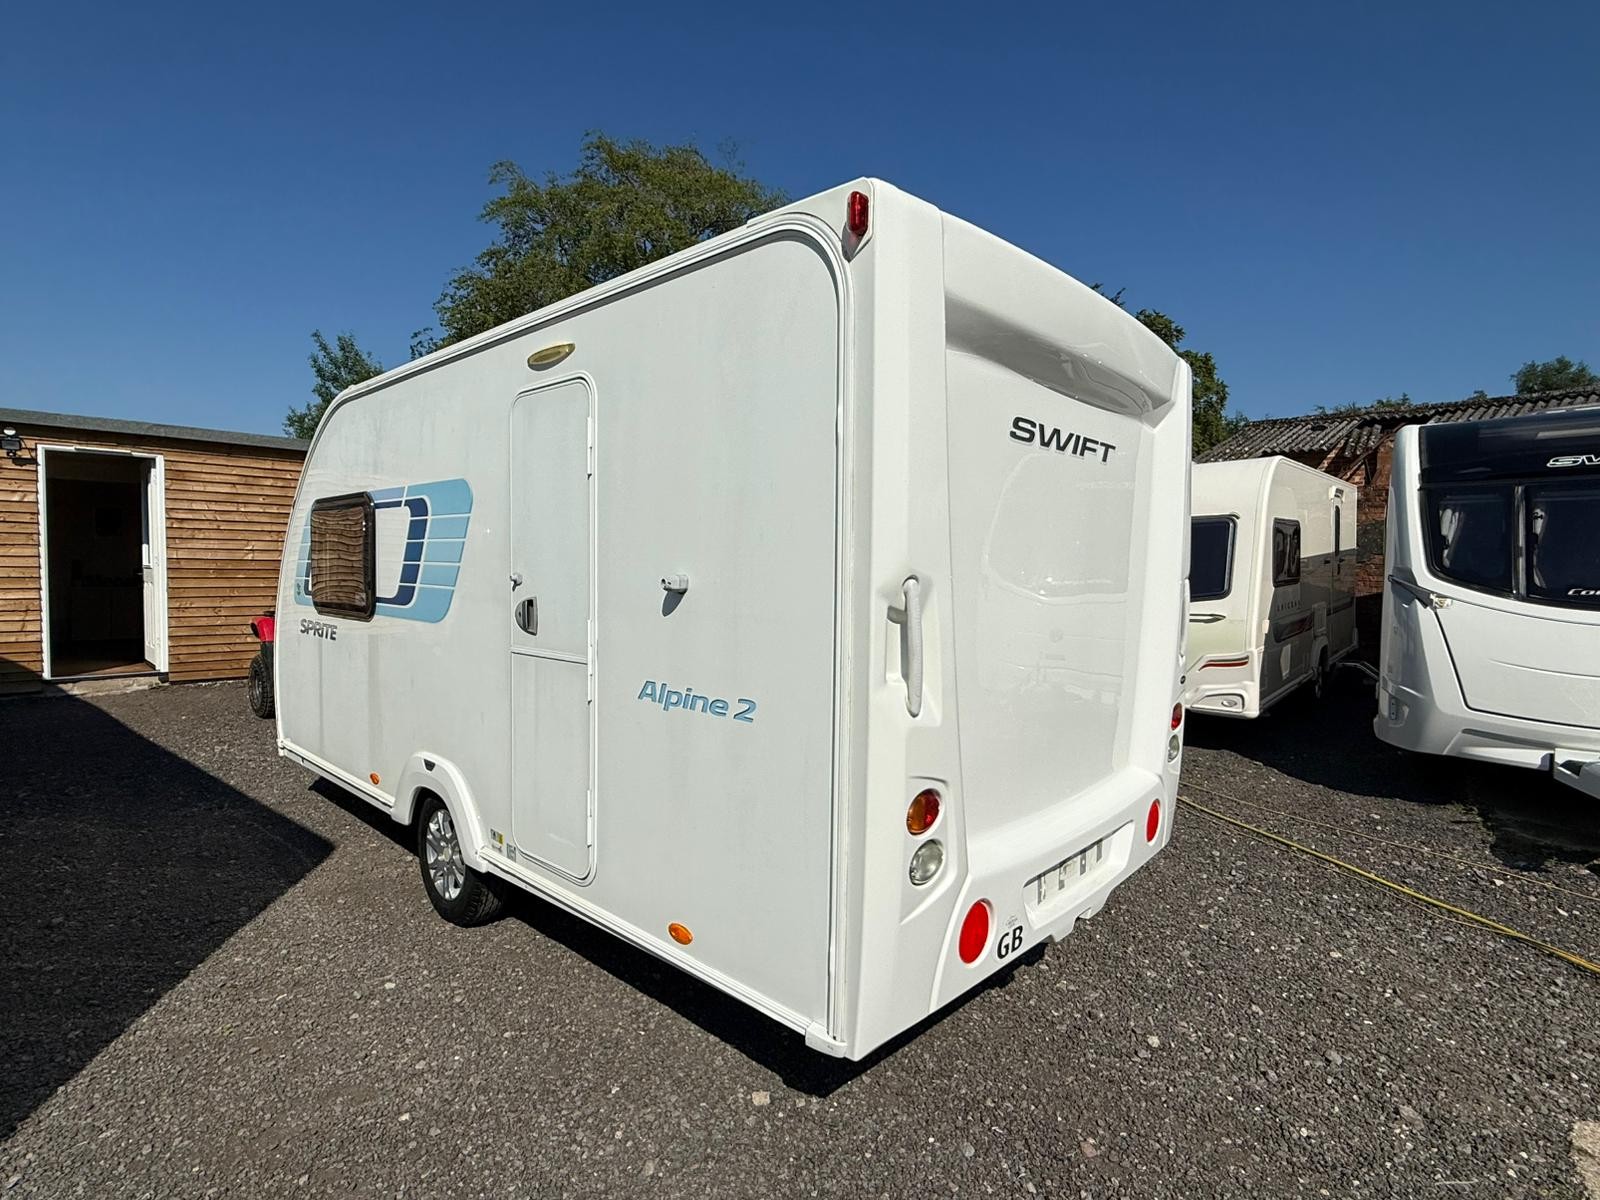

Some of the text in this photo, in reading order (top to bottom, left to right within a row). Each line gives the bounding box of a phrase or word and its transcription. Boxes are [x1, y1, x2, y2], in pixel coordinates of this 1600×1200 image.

[1009, 416, 1116, 463] SWIFT
[300, 618, 338, 641] SPRITE
[638, 680, 757, 723] Alpine 2
[997, 925, 1023, 960] GB
